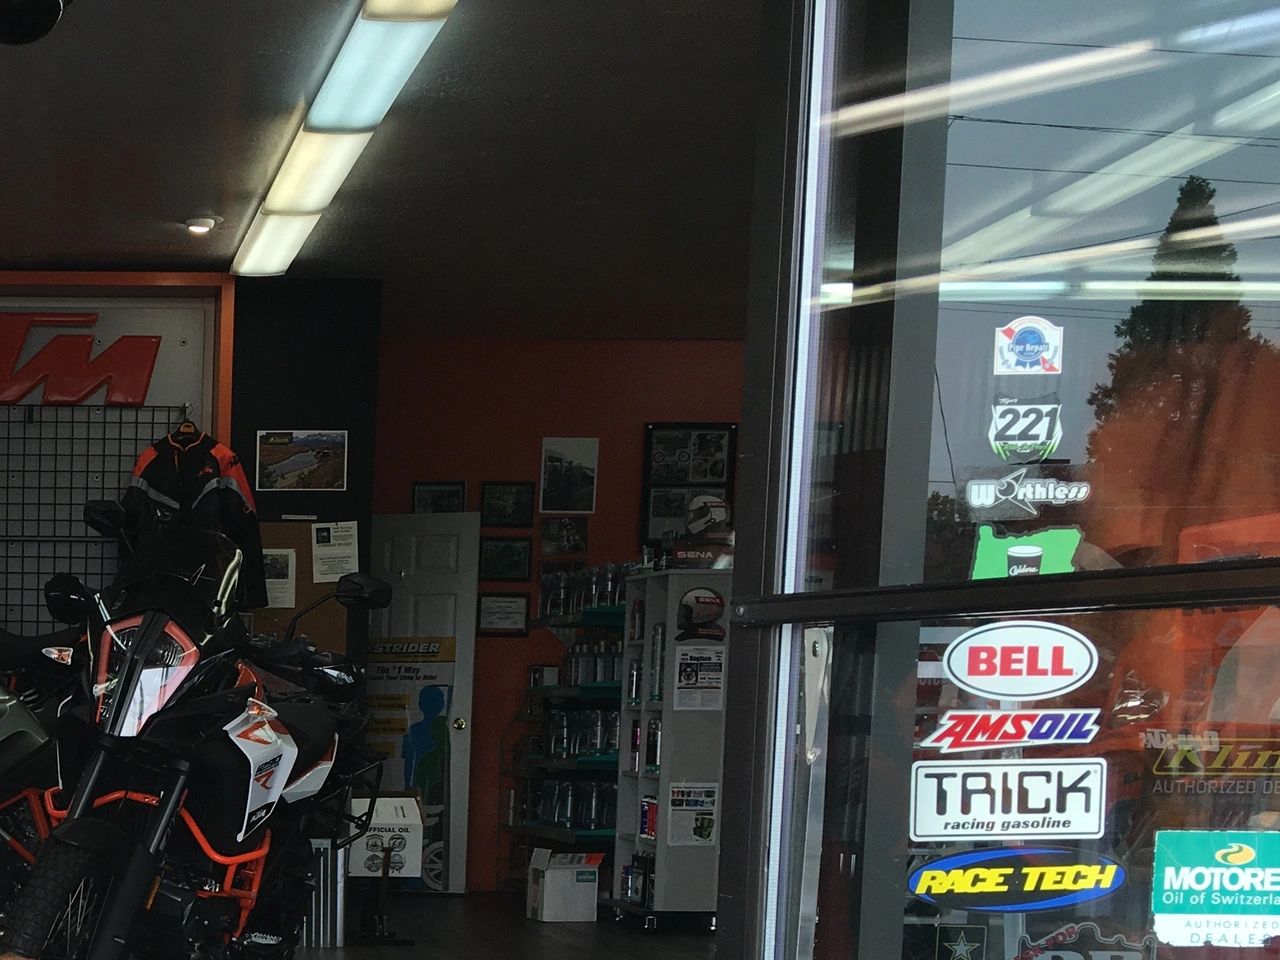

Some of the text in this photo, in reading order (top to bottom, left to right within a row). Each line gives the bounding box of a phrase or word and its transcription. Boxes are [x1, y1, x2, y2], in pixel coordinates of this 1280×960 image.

[994, 407, 1059, 441] 221
[677, 551, 713, 559] SENA
[373, 643, 440, 654] STRIDER
[967, 646, 1074, 676] BELL
[930, 713, 1094, 749] AMSOIL
[924, 770, 1092, 816] TRICK
[1153, 780, 1255, 794] AUTHORIZED
[943, 817, 1072, 832] racing gasoline
[915, 865, 1117, 894] RACE TECH
[1163, 866, 1280, 891] MOTORE
[1162, 892, 1183, 904] Oil
[1189, 892, 1206, 904] of
[1184, 920, 1279, 929] AUTHORIZED
